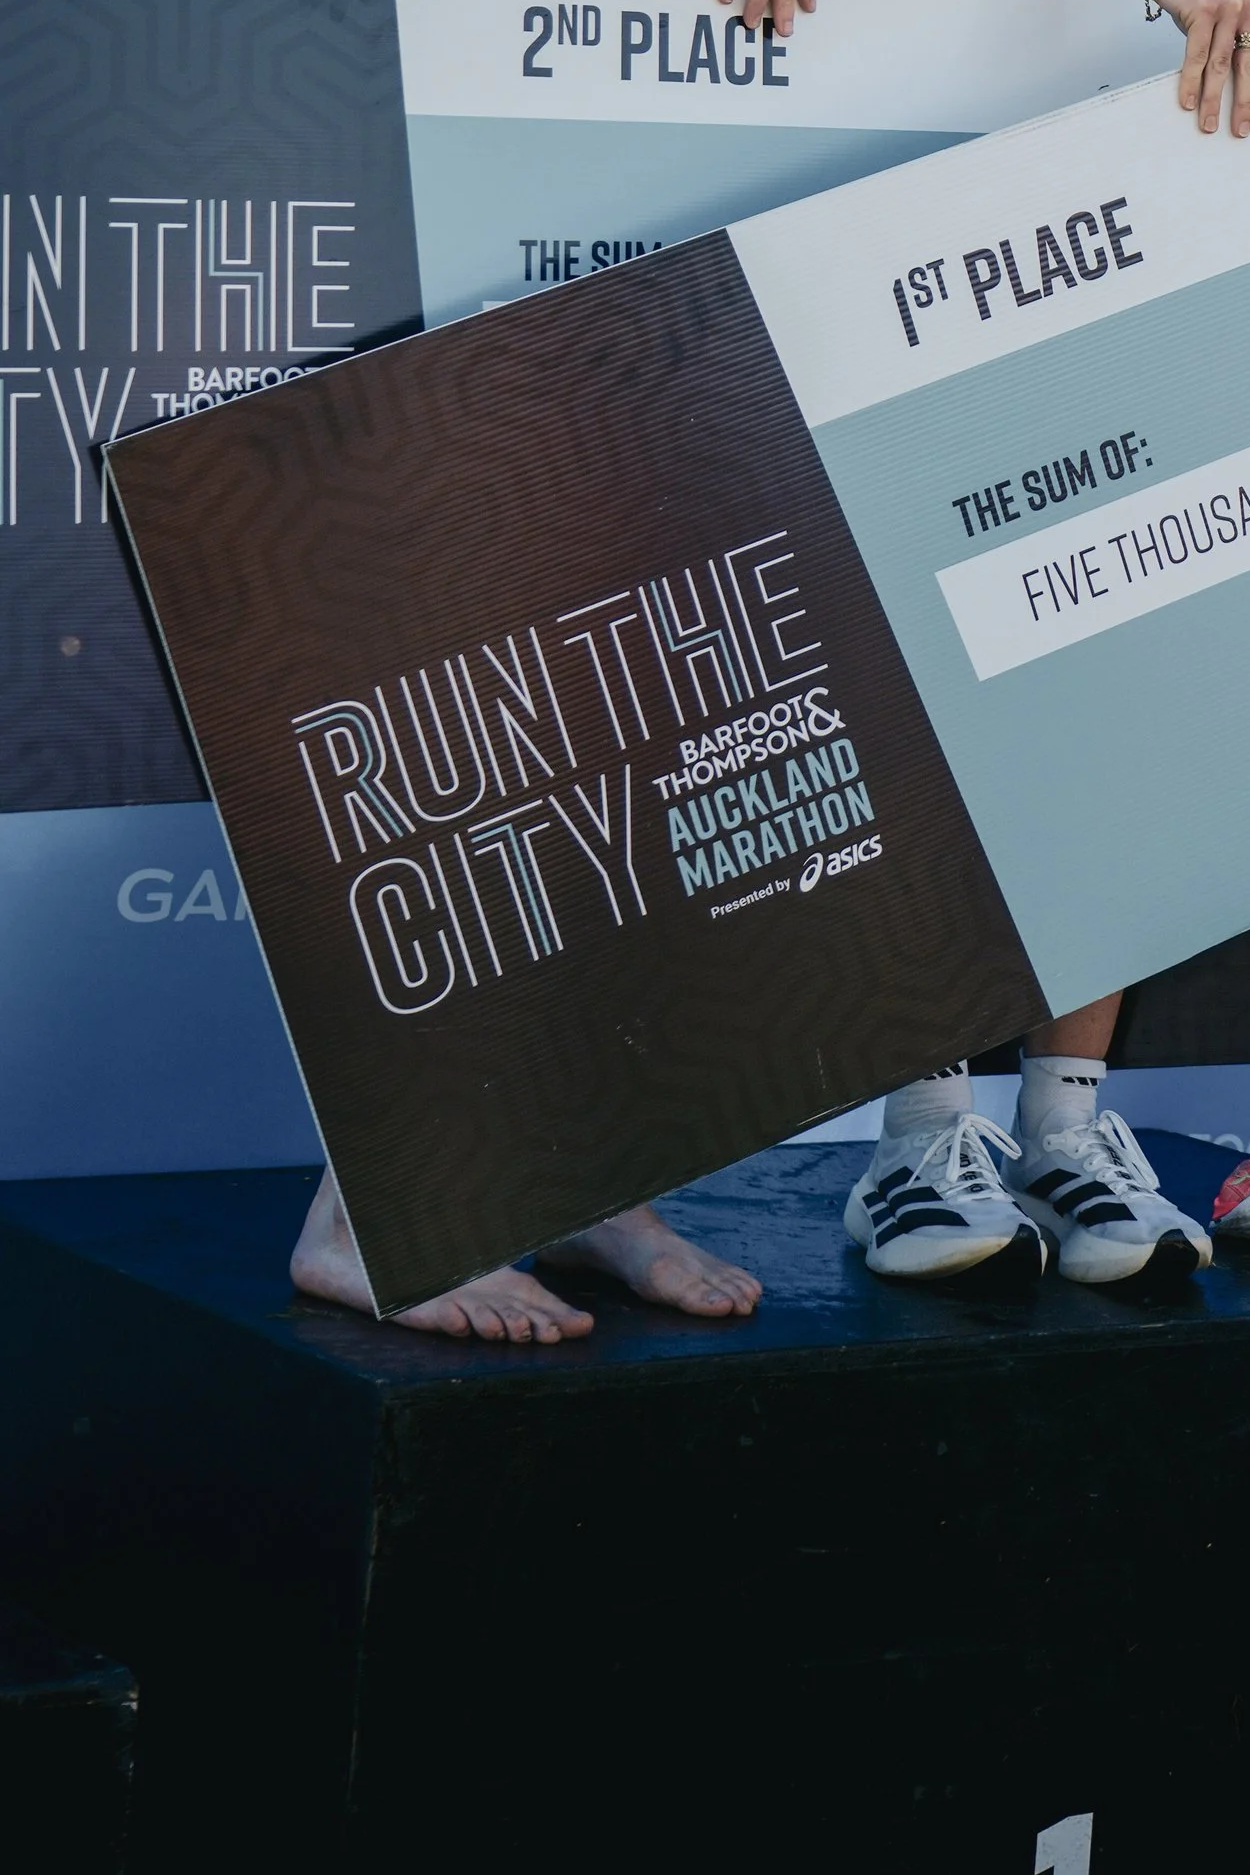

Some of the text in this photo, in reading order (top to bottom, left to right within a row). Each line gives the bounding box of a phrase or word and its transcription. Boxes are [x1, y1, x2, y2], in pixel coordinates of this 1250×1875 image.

[523, 3, 790, 87] 2ND PLACE
[108, 197, 356, 353] THE
[519, 239, 581, 281] THE
[892, 196, 1144, 347] 1ST PLACE
[951, 430, 1154, 538] THE SUM OF:
[1021, 546, 1109, 622] FIVE
[291, 530, 830, 865] RUN THE
[667, 737, 860, 853] AUCKLAND
[675, 780, 876, 897] MARATHON
[349, 763, 649, 1015] CITY
[710, 882, 774, 919] Presented
[774, 877, 792, 895] by
